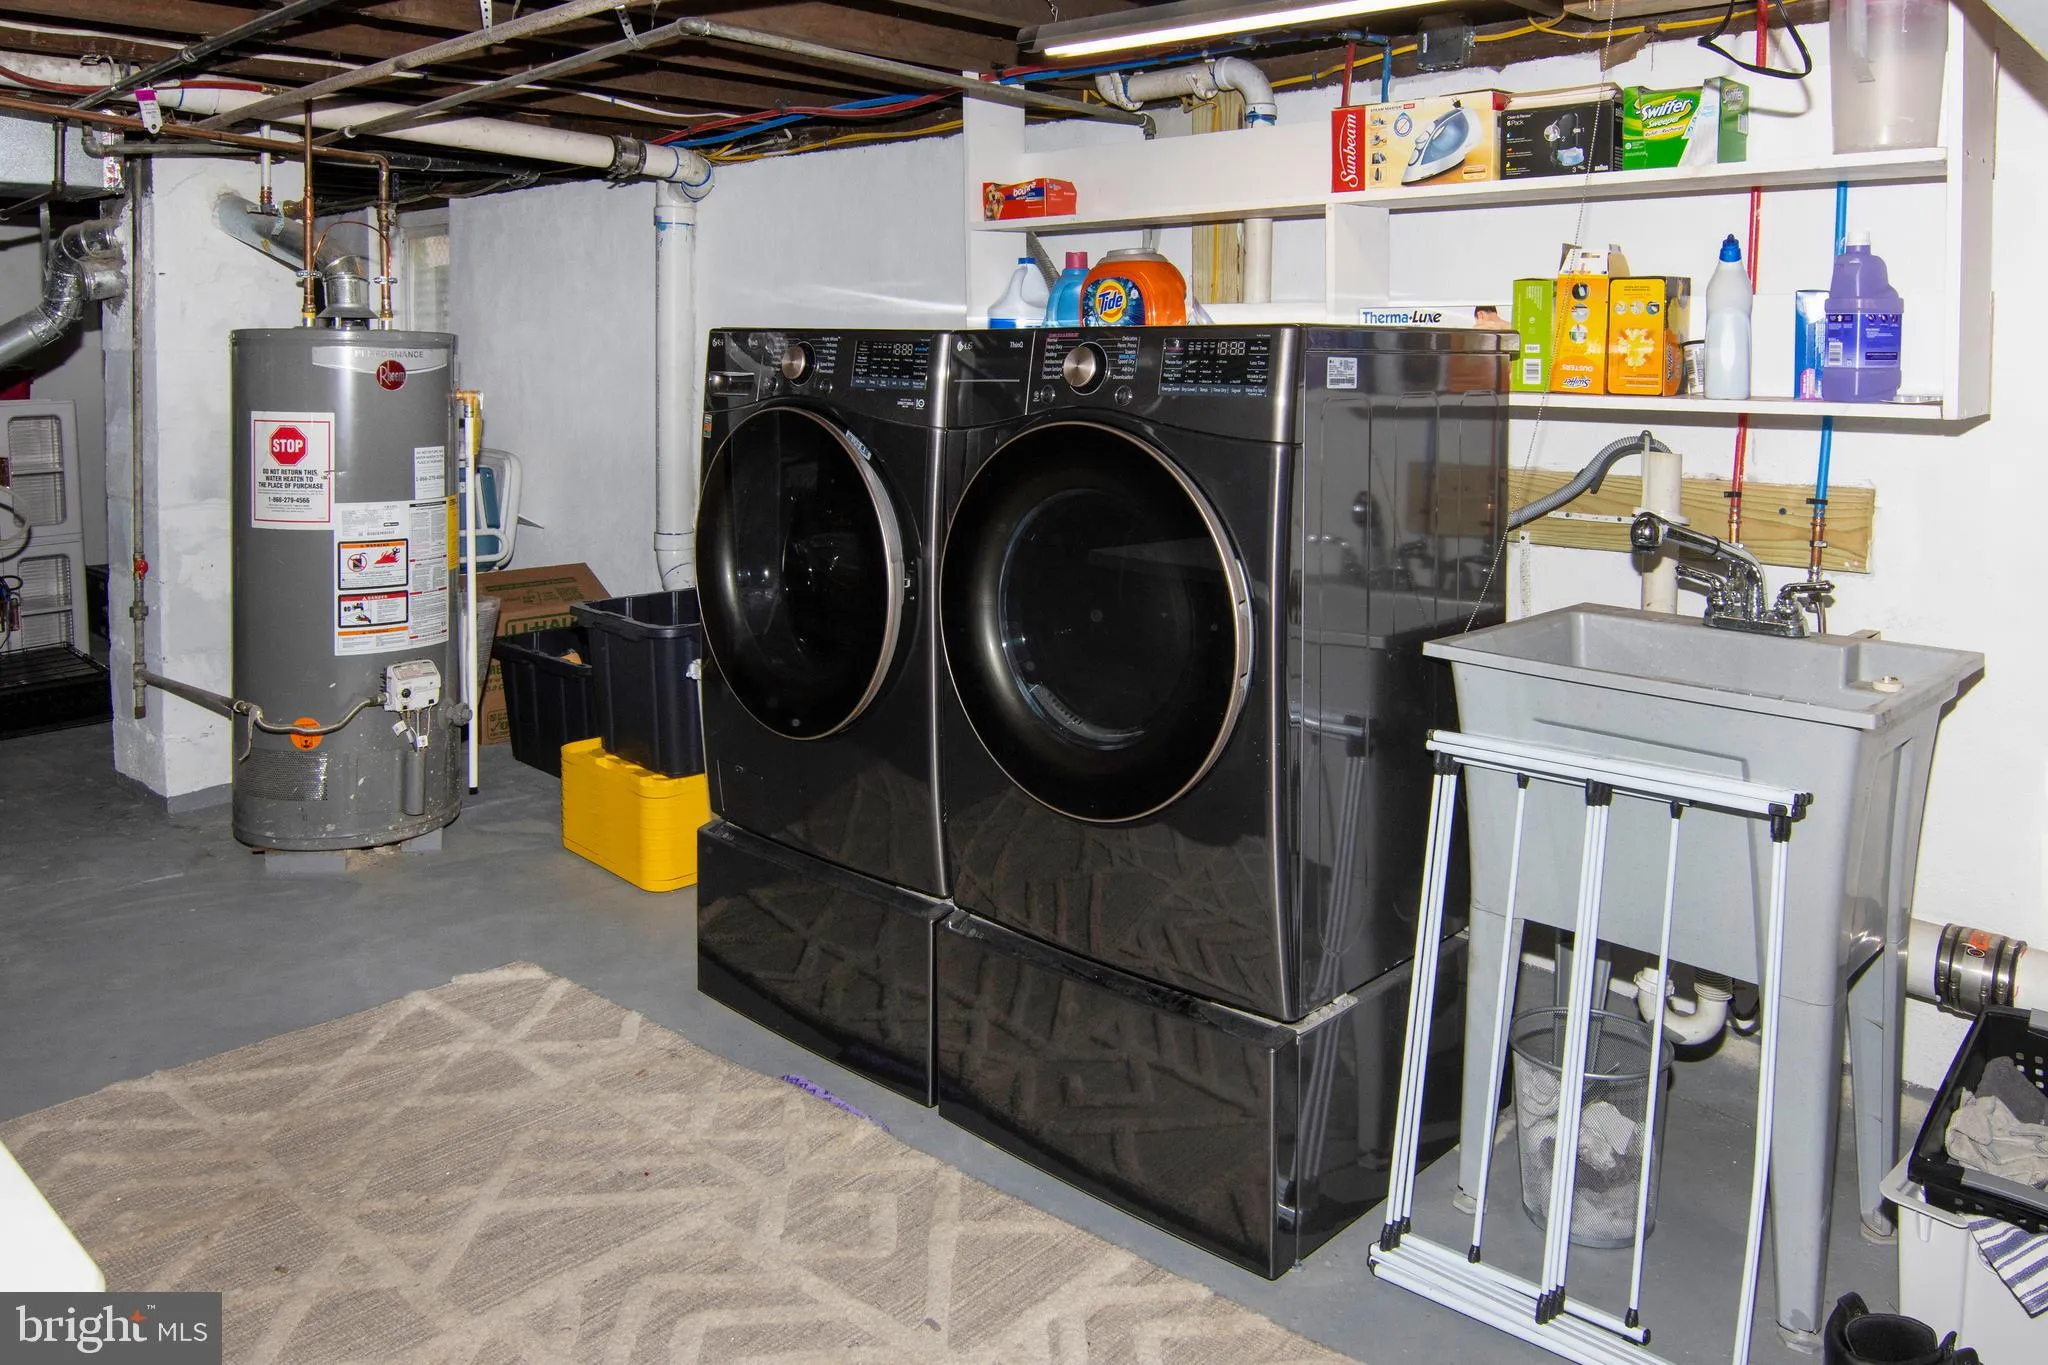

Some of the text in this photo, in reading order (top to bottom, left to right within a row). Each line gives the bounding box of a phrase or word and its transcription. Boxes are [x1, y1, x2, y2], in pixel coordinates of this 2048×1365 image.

[1641, 98, 1691, 121] Swiffer
[1647, 116, 1680, 129] Sweeper
[1339, 112, 1359, 188] Sunbeam
[1099, 291, 1123, 315] Tide
[1010, 341, 1024, 349] ThinQ
[379, 359, 405, 387] Rheem
[1563, 376, 1591, 389] Swiffer
[272, 438, 304, 453] STOP
[280, 468, 303, 476] RETURN
[303, 469, 318, 477] THIS
[292, 482, 324, 490] PURCHASE
